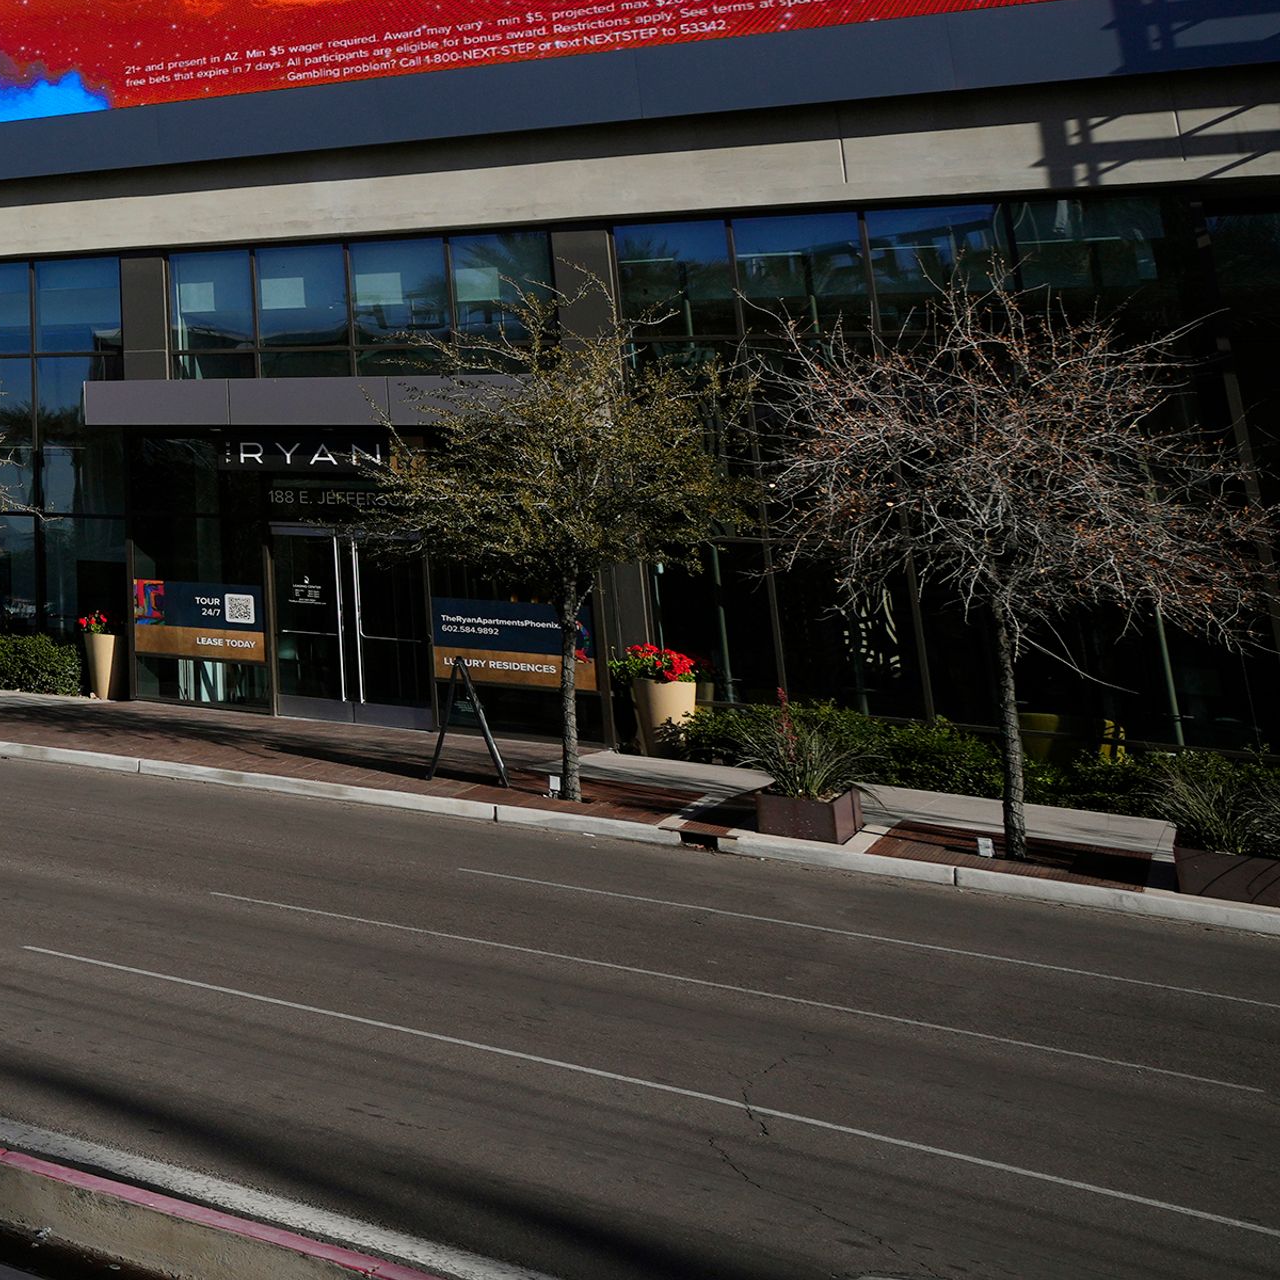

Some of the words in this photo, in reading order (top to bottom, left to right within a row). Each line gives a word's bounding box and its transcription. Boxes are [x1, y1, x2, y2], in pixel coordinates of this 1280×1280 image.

[125, 76, 146, 88] free
[148, 73, 171, 85] bets
[173, 70, 194, 82] that
[197, 66, 229, 81] expire
[232, 63, 242, 73] in
[244, 62, 252, 72] 7
[286, 57, 301, 68] All
[303, 49, 370, 67] participants
[372, 46, 392, 57] are
[395, 38, 440, 56] eligible
[442, 36, 459, 48] for
[462, 32, 502, 45] bonus
[553, 16, 630, 33] Restrictions
[634, 10, 676, 26] apply.
[680, 6, 708, 18] See
[712, 0, 755, 14] terms
[144, 61, 165, 71] and
[167, 56, 207, 72] present
[210, 54, 220, 63] in
[246, 48, 266, 59] Min
[269, 45, 285, 57] $5
[288, 41, 324, 55] wager
[327, 34, 379, 50] required.
[383, 27, 421, 41] Award
[426, 24, 453, 37] may
[456, 21, 483, 35] vary
[497, 15, 520, 26] min
[552, 3, 615, 21] projected
[621, 0, 650, 10] max
[286, 67, 340, 82] Gambling
[342, 58, 397, 77] problem?
[399, 55, 423, 68] Call
[424, 42, 536, 64] 1-800-NEXT-STEP
[538, 40, 552, 50] or
[583, 27, 659, 46] NEXTSTEP
[662, 26, 676, 36] to
[240, 442, 381, 465] RYAN
[268, 490, 294, 504] 188
[299, 491, 313, 504] E.
[317, 491, 401, 507] JEFFERS
[195, 596, 220, 606] TOUR
[201, 607, 221, 617] 24/7
[441, 614, 562, 630] TheRyanApartmentsPhoenix.
[441, 624, 499, 636] 602.584.9892
[196, 637, 223, 647] LEASE
[226, 638, 256, 649] TODAY
[444, 657, 487, 668] LUURY
[489, 658, 557, 674] RESIDENCES
